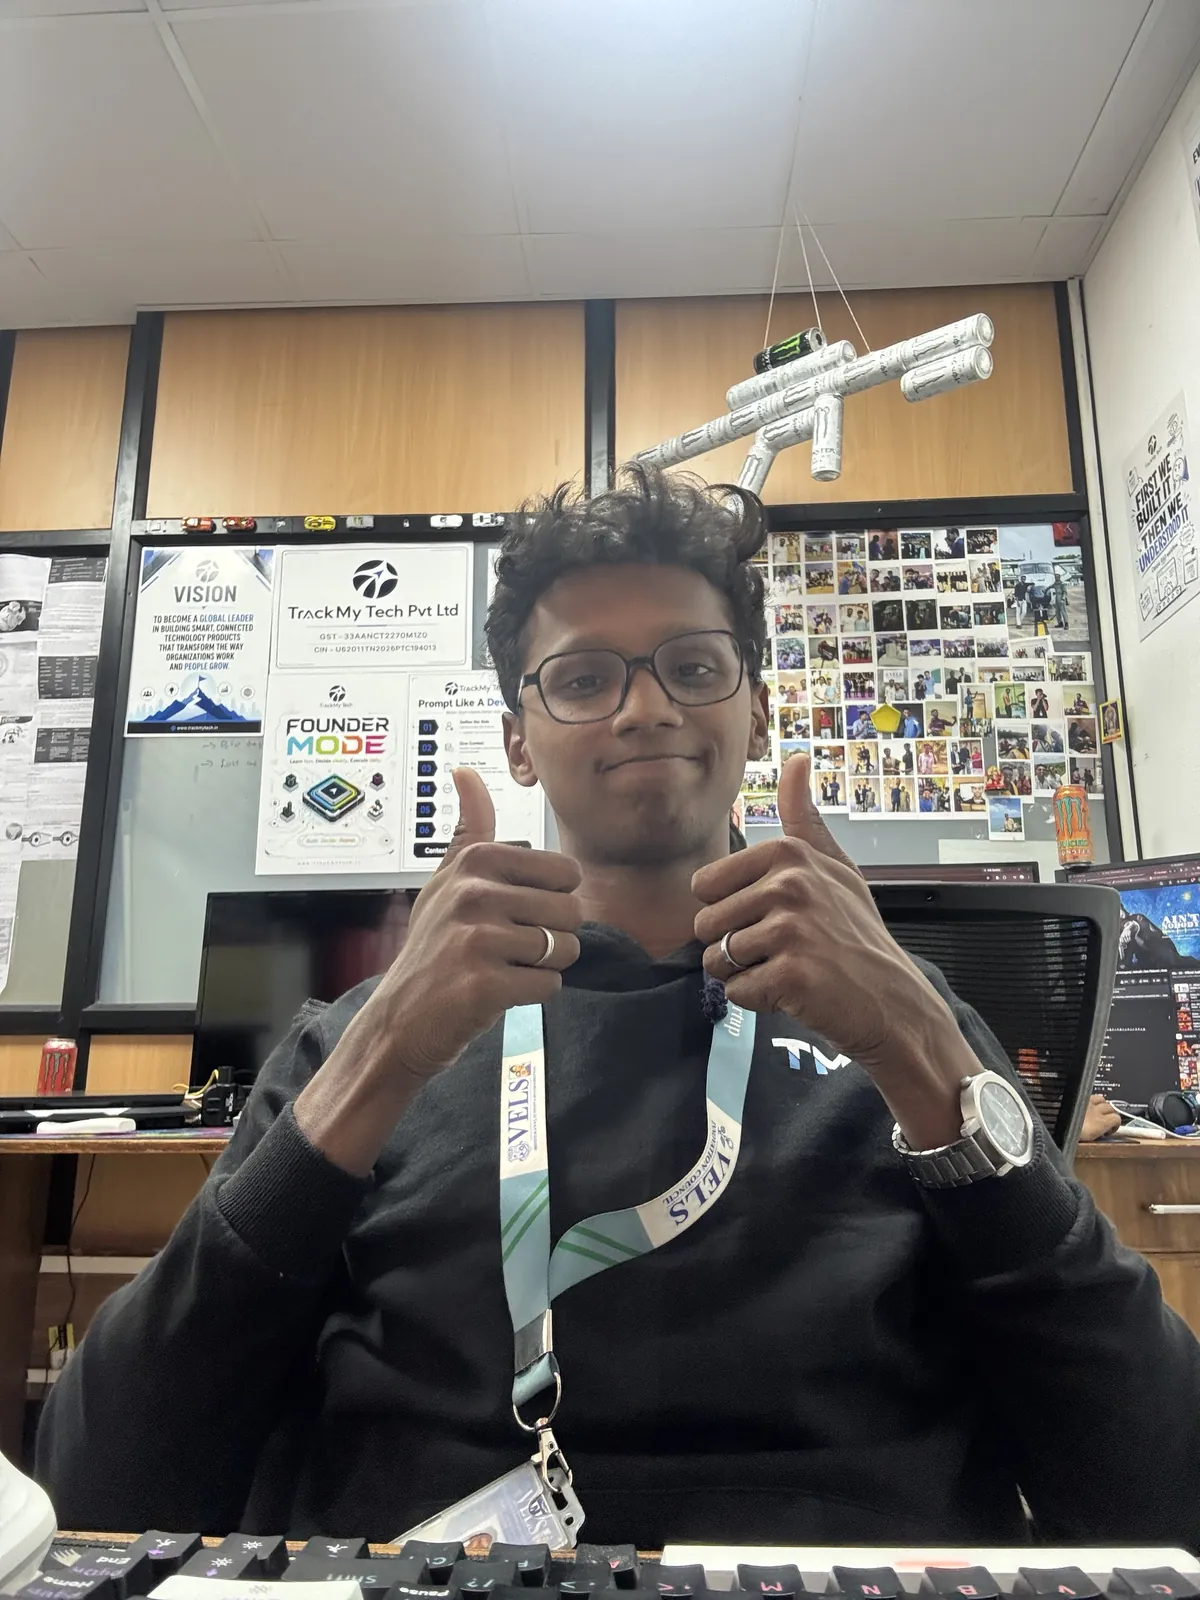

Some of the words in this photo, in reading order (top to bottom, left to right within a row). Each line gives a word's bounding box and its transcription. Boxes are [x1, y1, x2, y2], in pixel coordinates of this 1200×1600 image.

[1135, 472, 1158, 512] FIRST
[1158, 453, 1172, 485] WE
[1136, 486, 1162, 533] BUILT
[1162, 477, 1171, 501] IT
[1142, 513, 1167, 550] THEN
[1168, 492, 1182, 522] WE
[1139, 515, 1180, 572] UNDERSTOOD
[1181, 505, 1189, 528] IT
[174, 585, 237, 602] VISION
[366, 604, 403, 618] Tech
[408, 604, 432, 617] Pvt
[437, 603, 459, 617] Ltd
[154, 616, 162, 624] TO
[164, 616, 191, 624] BECOME
[228, 614, 254, 622] LEADER
[192, 624, 215, 633] SMART,
[216, 624, 254, 632] CONNECTED
[164, 634, 206, 642] TECHNOLOGY
[207, 633, 241, 641] PRODUCTS
[159, 644, 174, 652] THAT
[216, 643, 228, 651] THE
[229, 643, 244, 651] WAY
[166, 653, 215, 661] ORGANIZATIONS
[216, 652, 234, 660] WORK
[169, 663, 183, 671] AND
[418, 699, 453, 709] Prompt
[456, 699, 474, 707] Like
[487, 698, 504, 706] Dev
[286, 717, 389, 736] FOUNDER
[287, 735, 387, 755] MODE
[422, 744, 432, 752] 02
[421, 785, 431, 793] 04
[419, 826, 429, 834] 06
[724, 1006, 744, 1036] rtup
[508, 1078, 530, 1144] VELS
[663, 1169, 702, 1205] COUNCIL
[670, 1151, 731, 1226] VELS
[96, 1556, 131, 1565] End
[43, 1576, 94, 1588] Home
[761, 1582, 783, 1591] M
[399, 1587, 450, 1597] Pause
[861, 1585, 881, 1595] N
[957, 1585, 978, 1595] B
